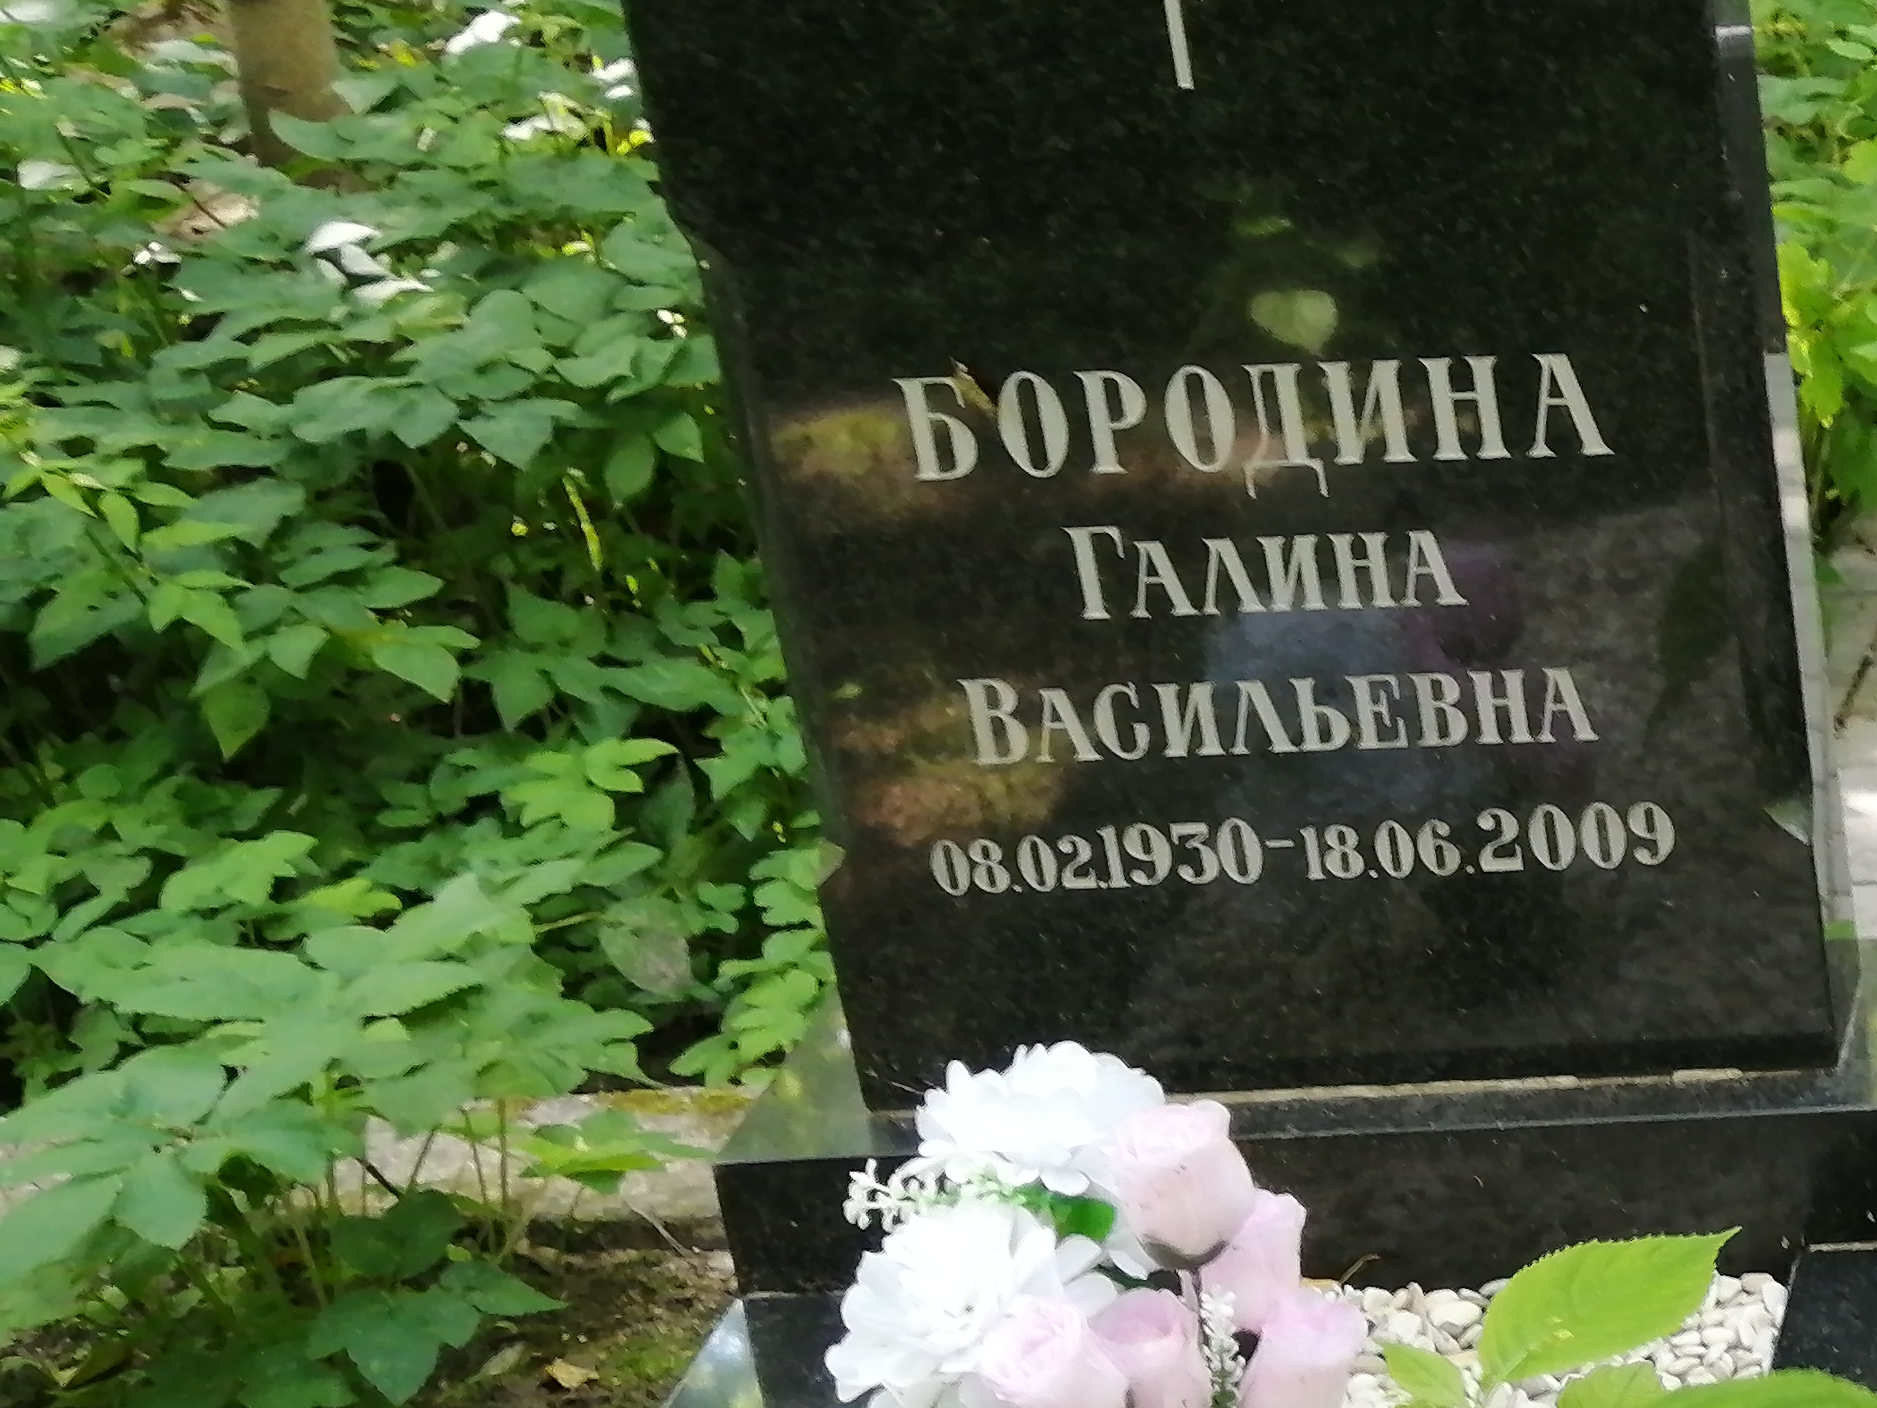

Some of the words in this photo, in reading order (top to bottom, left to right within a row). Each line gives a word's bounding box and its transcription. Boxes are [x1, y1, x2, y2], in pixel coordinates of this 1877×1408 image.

[891, 352, 1615, 500] БОРОДИНА
[1062, 524, 1469, 621] ГАЛИНА
[957, 666, 1600, 767] ВАСИЛЬЕВНА
